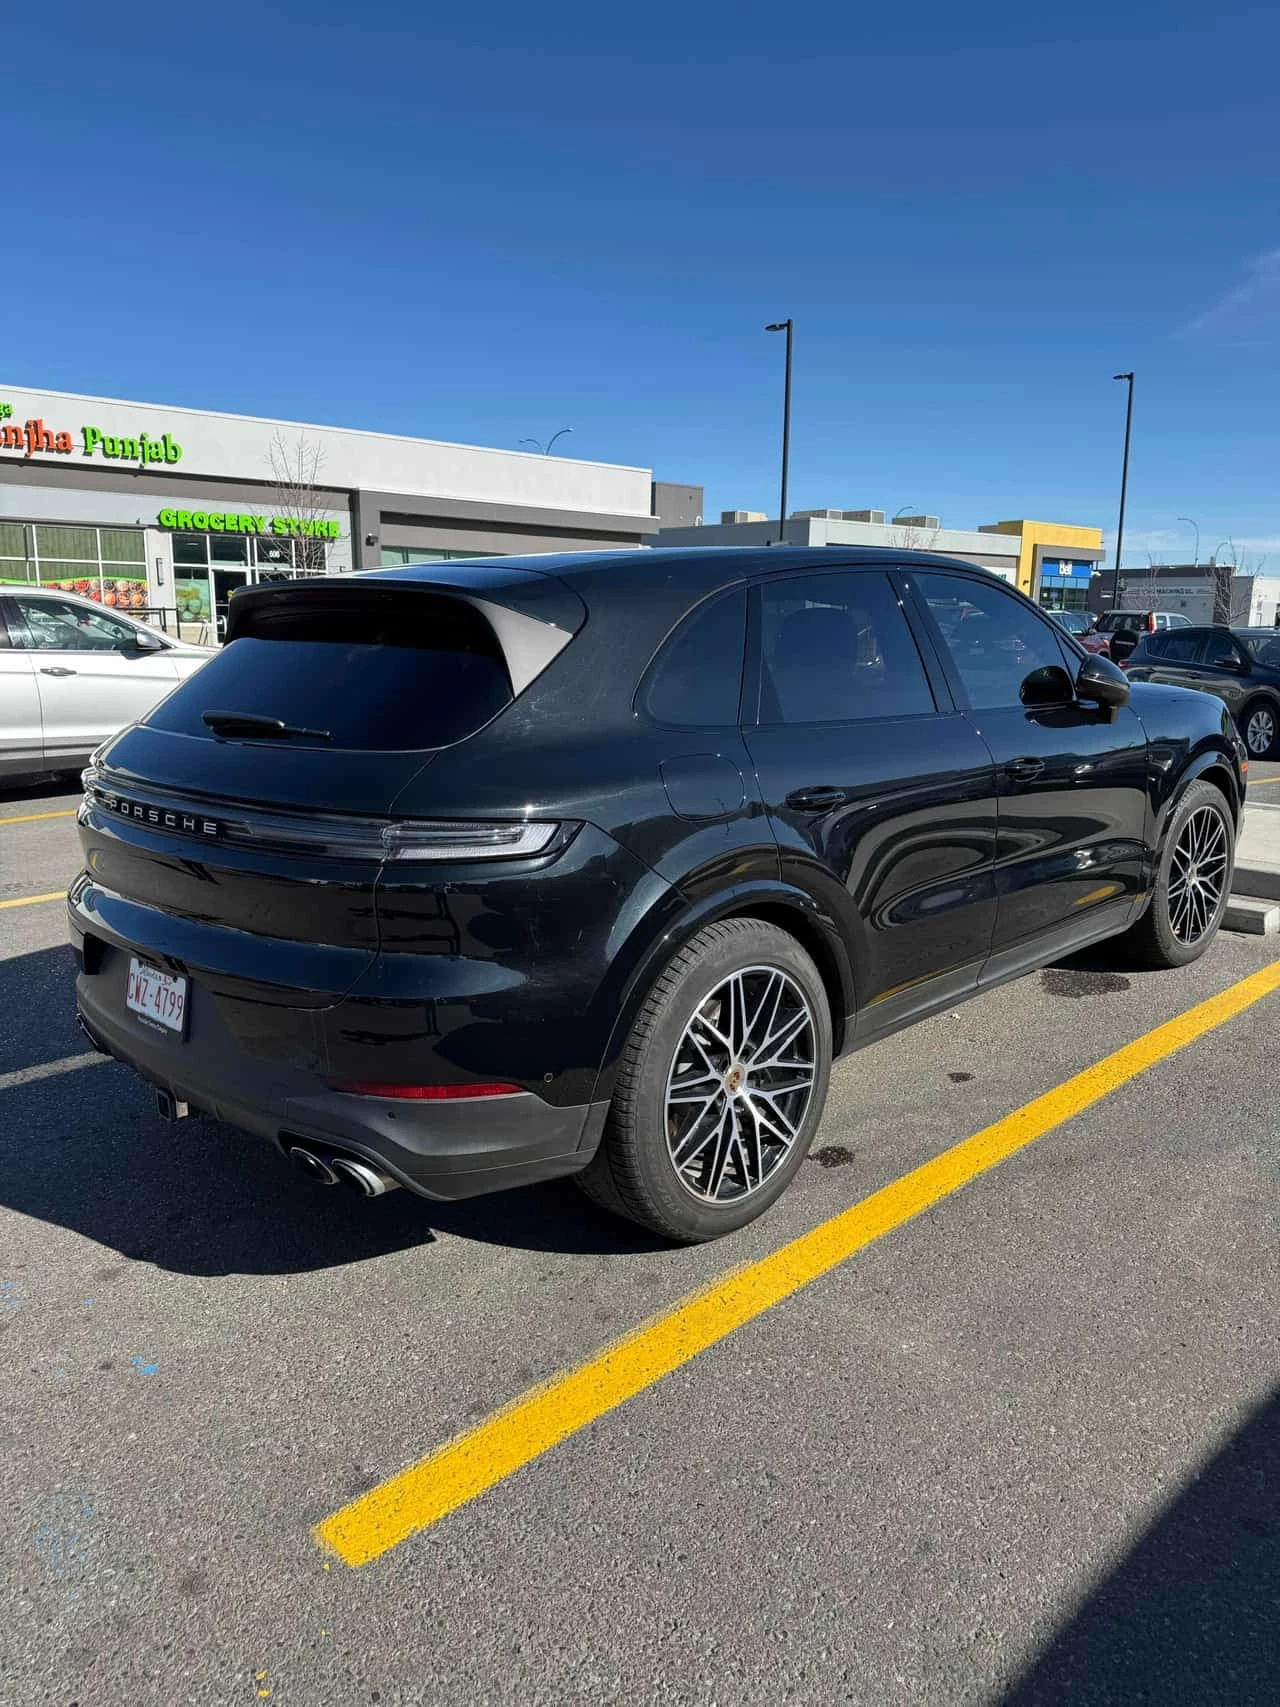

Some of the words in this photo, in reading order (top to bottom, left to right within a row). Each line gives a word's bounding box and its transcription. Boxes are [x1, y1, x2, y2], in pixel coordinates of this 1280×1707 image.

[0, 418, 74, 458] njha
[81, 425, 182, 469] Punjab
[158, 508, 267, 535] GROCERY
[271, 515, 341, 539] STORE
[106, 798, 217, 835] PORSCHE
